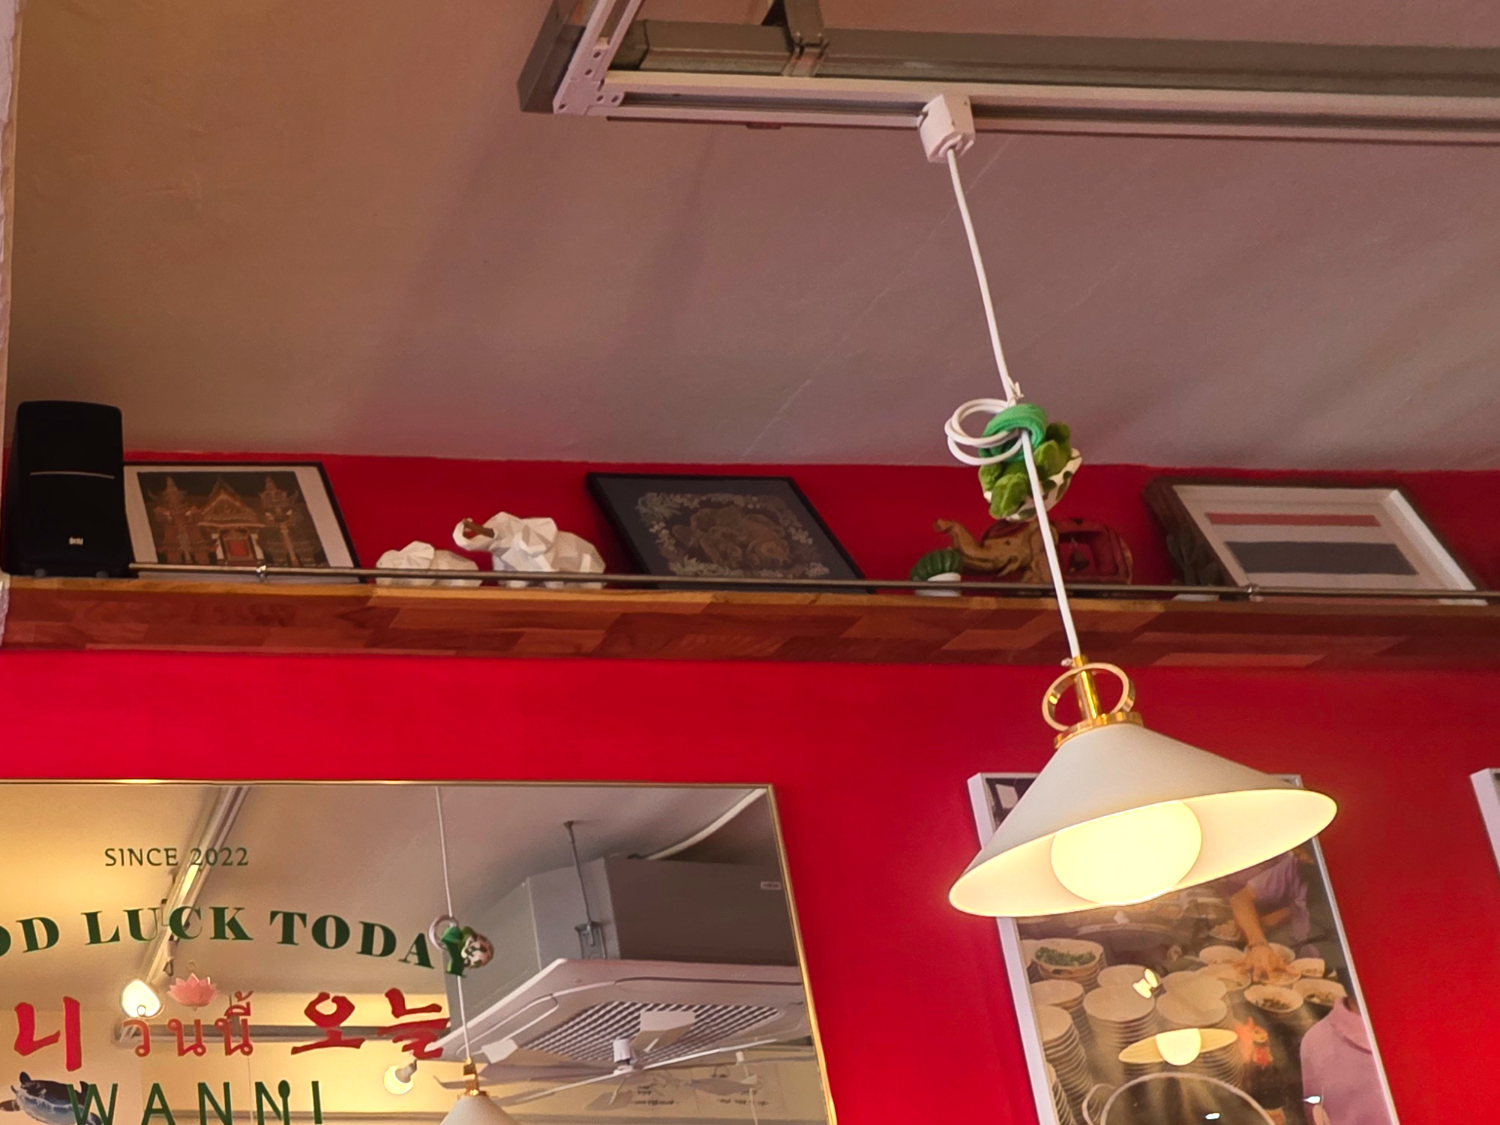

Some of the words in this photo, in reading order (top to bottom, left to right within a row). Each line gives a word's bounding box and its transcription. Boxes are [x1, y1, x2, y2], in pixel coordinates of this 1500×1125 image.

[104, 847, 179, 867] SINCE
[190, 847, 249, 867] 2022
[80, 905, 254, 946] LUCK
[269, 910, 474, 978] TODAY
[290, 987, 451, 1060] 오늘
